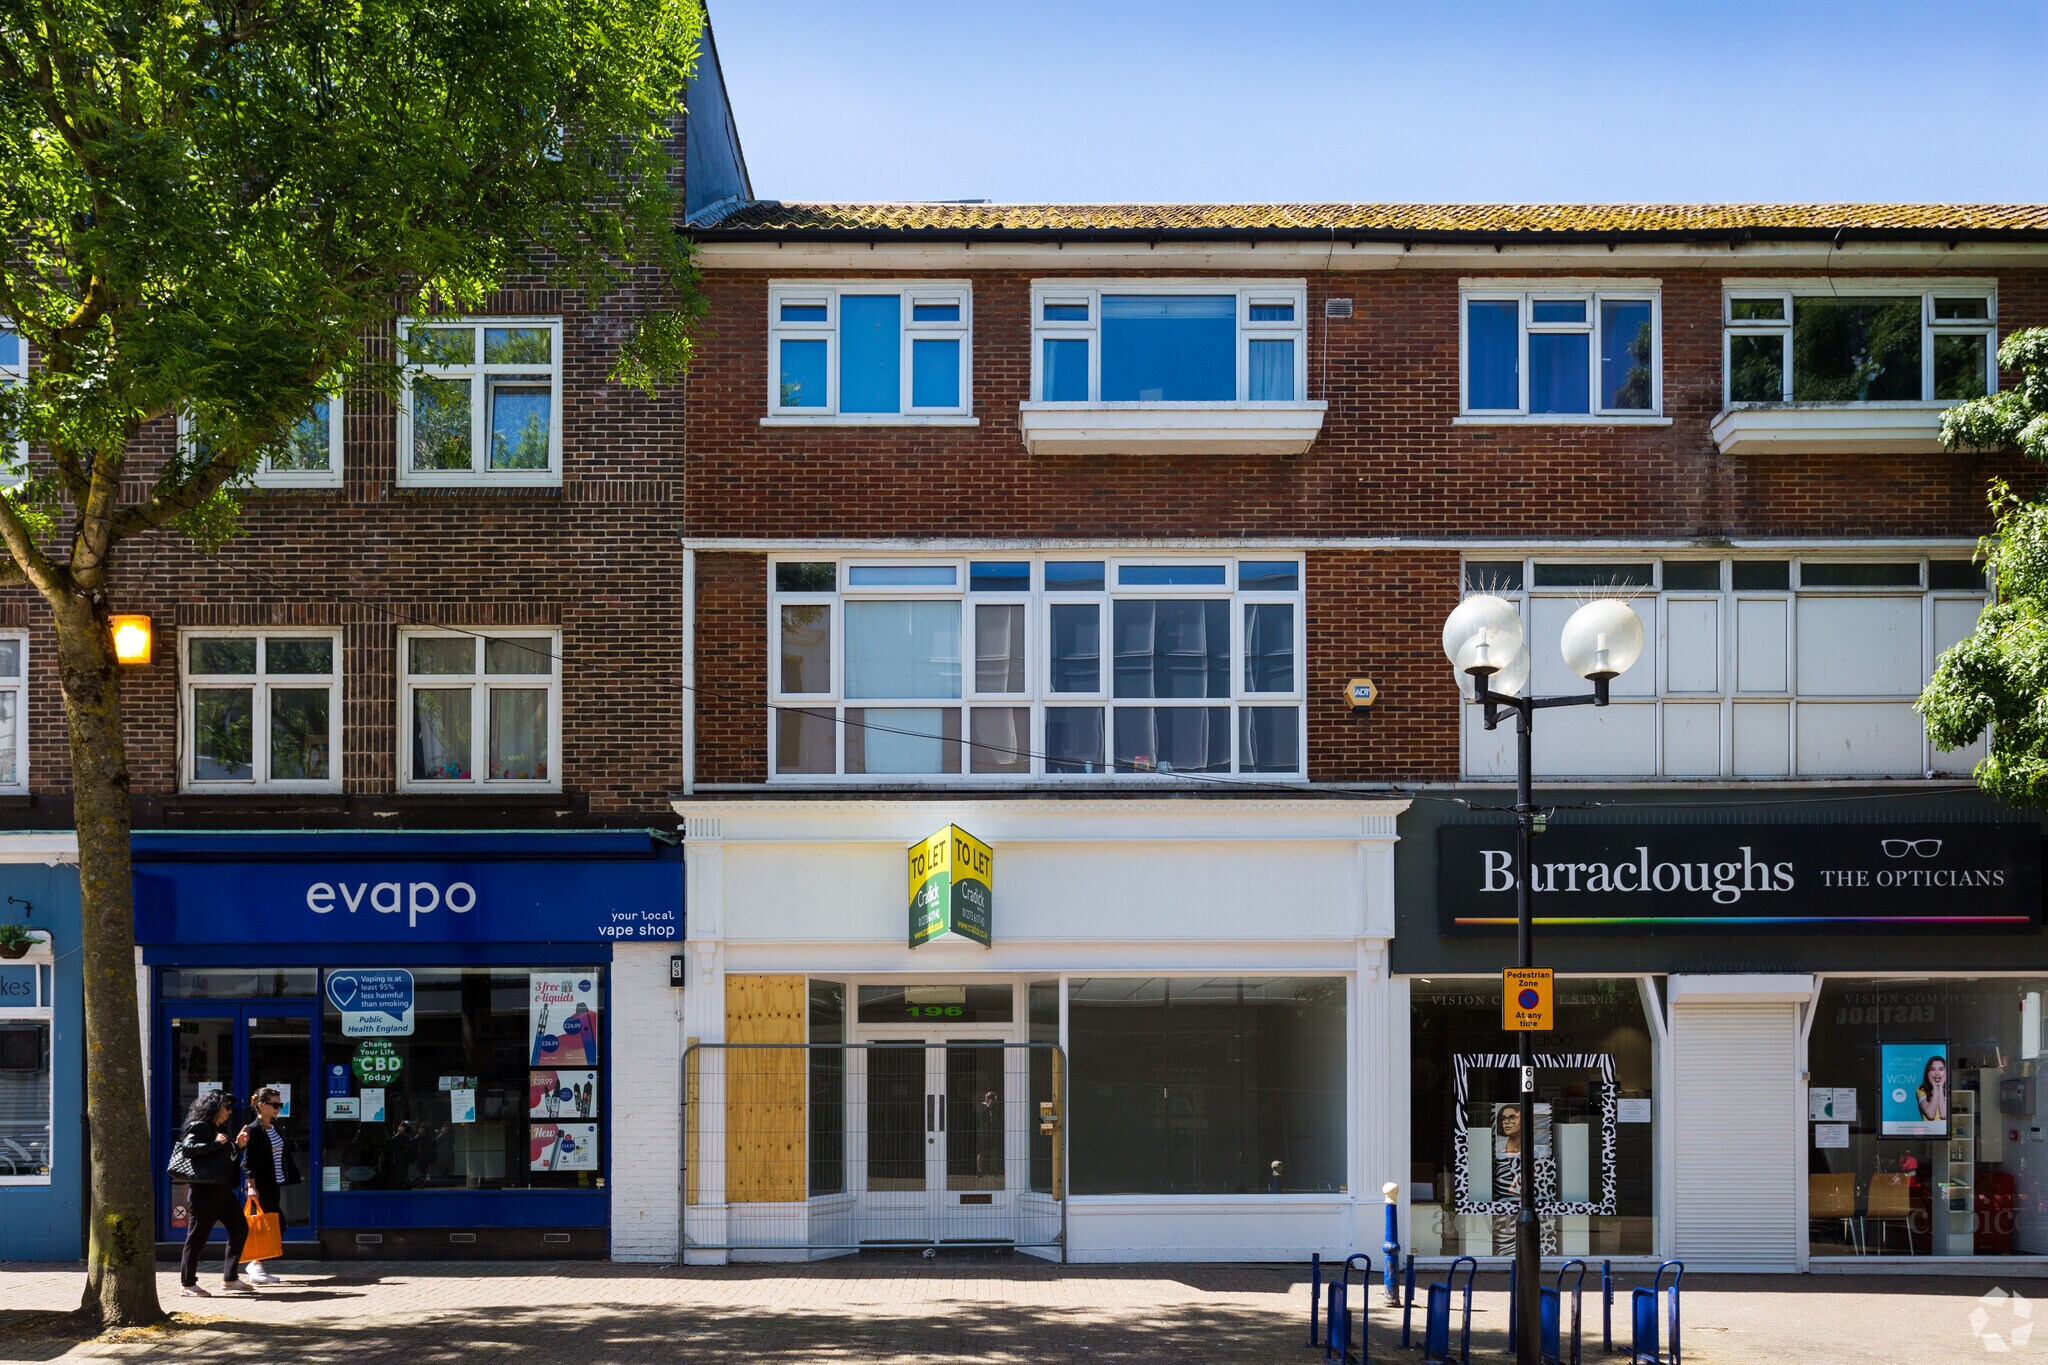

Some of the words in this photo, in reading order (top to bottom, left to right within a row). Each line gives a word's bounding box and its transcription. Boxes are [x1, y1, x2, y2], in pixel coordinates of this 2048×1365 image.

[1354, 687, 1370, 697] ADT
[911, 853, 925, 880] TO
[927, 840, 946, 871] LET
[955, 837, 971, 866] TO
[973, 848, 990, 878] LET
[1479, 846, 1795, 904] Barracloughs
[1820, 870, 1870, 887] THE
[1876, 870, 2005, 887] OPTICIANS
[917, 882, 940, 908] Cradick
[961, 881, 985, 908] Cradick
[306, 882, 477, 928] evapo
[611, 912, 638, 922] your
[641, 911, 675, 920] local
[598, 926, 634, 939] vape
[639, 923, 675, 939] shop
[361, 976, 386, 984] Vaping
[379, 983, 395, 991] 95%
[535, 981, 541, 992] 3
[541, 981, 560, 994] free
[376, 991, 404, 999] harmful
[534, 993, 574, 1004] e-liquids
[1432, 995, 1486, 1005] VISION
[1572, 994, 1618, 1004] STYLE
[1844, 993, 1899, 1004] VISION
[379, 1000, 409, 1008] smoking
[905, 1006, 963, 1017] 196
[348, 1025, 374, 1033] Health
[376, 1025, 409, 1033] England
[363, 1041, 393, 1049] Change
[541, 1039, 558, 1047] £24.99
[1533, 1034, 1574, 1047] CHOO
[360, 1056, 401, 1071] CBD
[362, 1073, 392, 1083] Today
[1886, 1075, 1917, 1084] WOW
[533, 1127, 556, 1138] New
